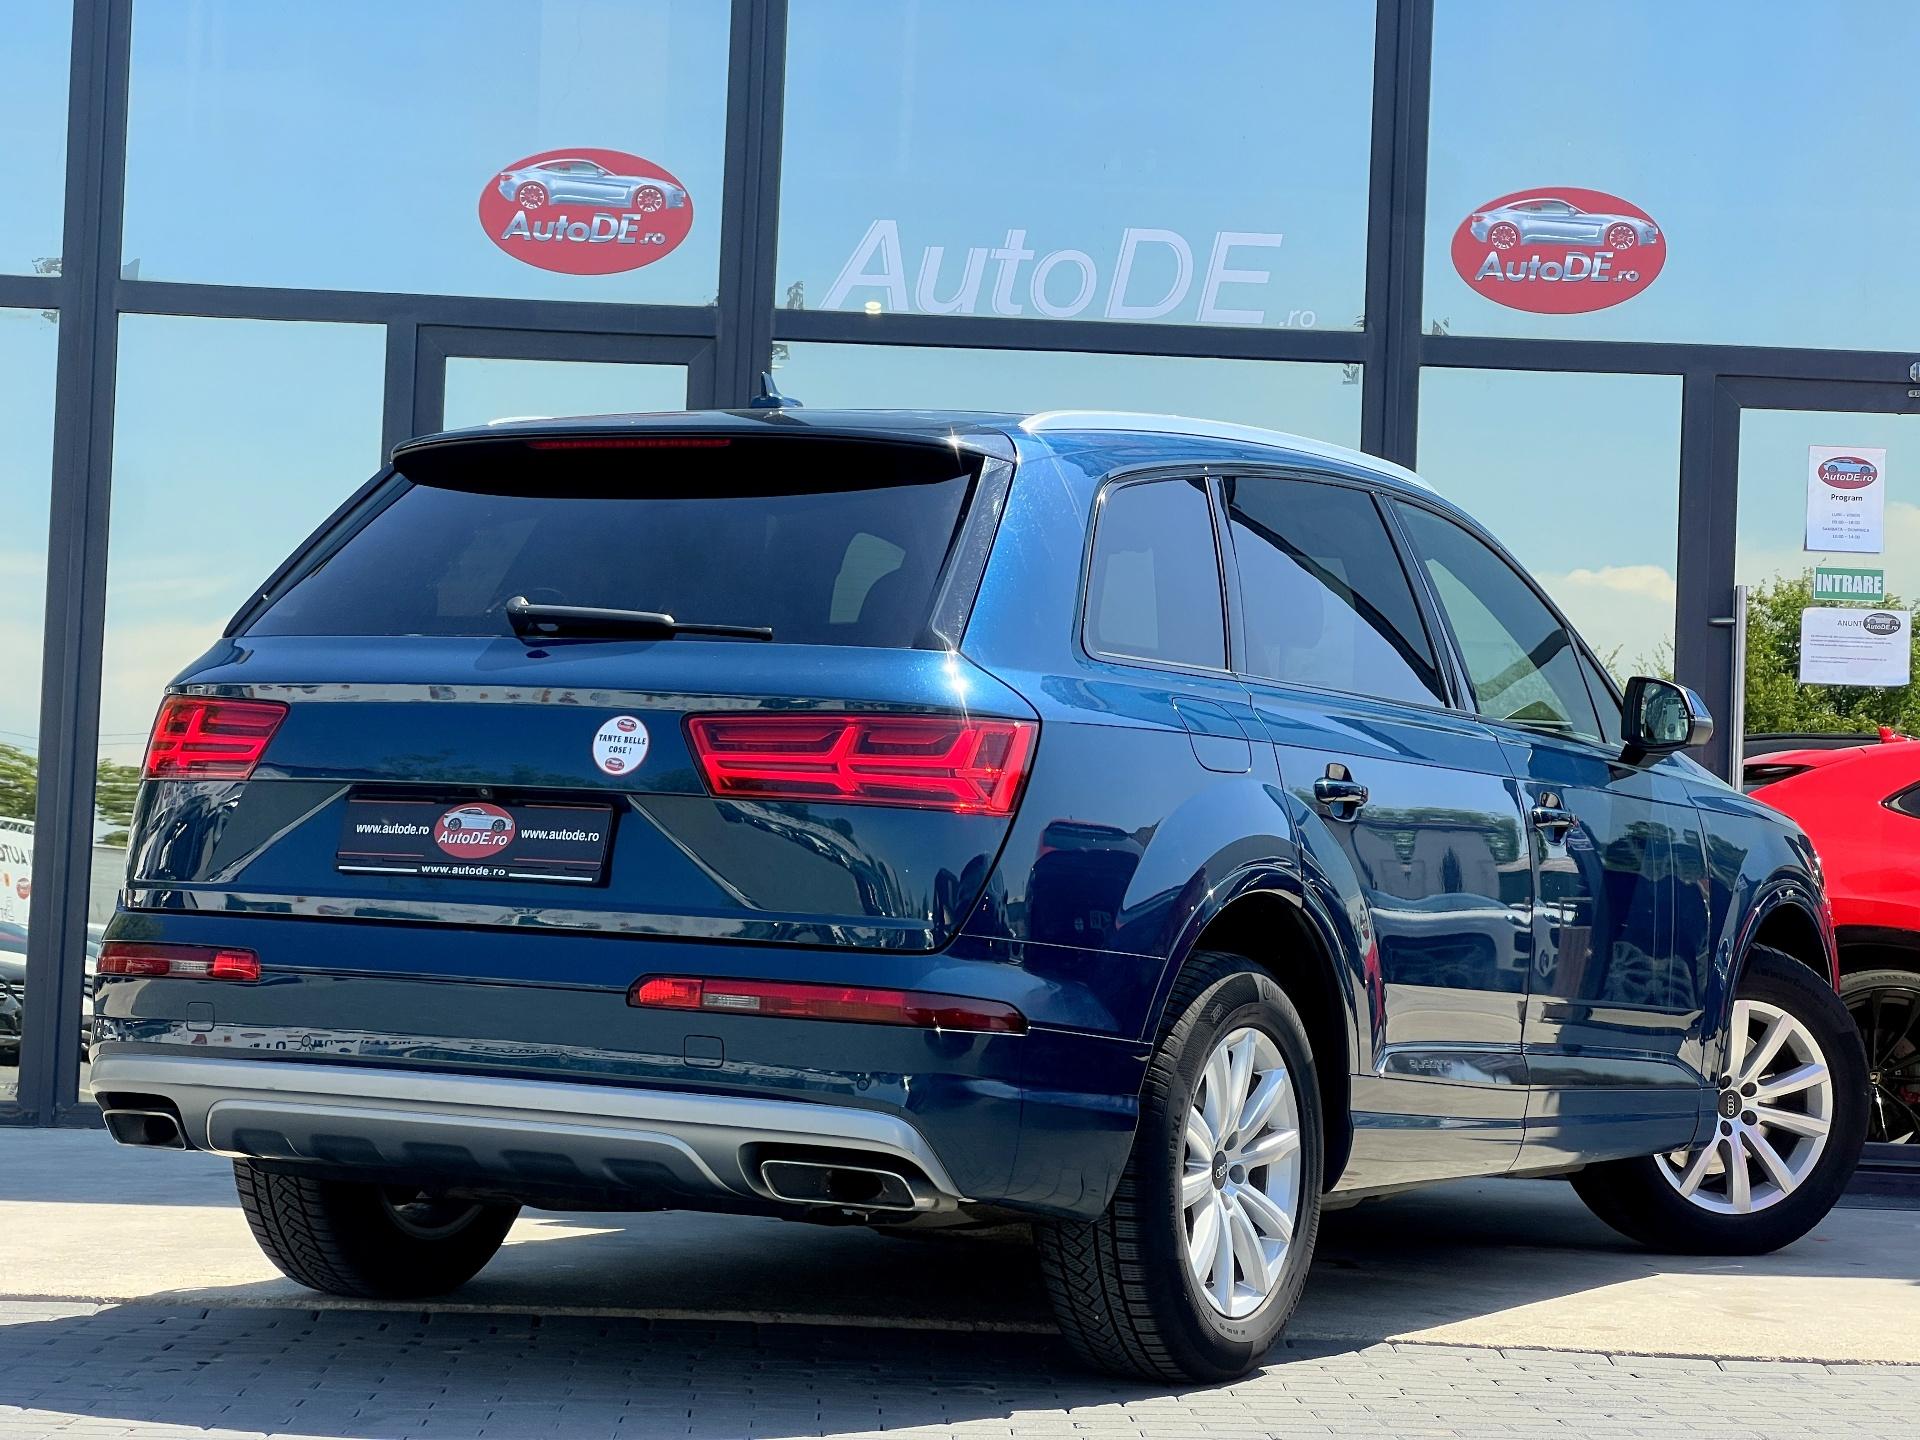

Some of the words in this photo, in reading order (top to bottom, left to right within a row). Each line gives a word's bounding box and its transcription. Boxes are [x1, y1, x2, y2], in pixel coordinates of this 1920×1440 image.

[1822, 472, 1874, 482] AutoDE.ro
[1830, 493, 1863, 503] Program
[1816, 573, 1882, 594] INTRARE
[1837, 619, 1863, 628] ANUNT
[599, 734, 621, 743] TANTE
[624, 736, 647, 745] BELLE
[608, 745, 627, 754] COSE
[356, 822, 430, 836] www.autode.ro
[520, 828, 600, 842] www.autode.ro
[437, 830, 508, 846] AutoDE.ro
[420, 863, 506, 877] www.autode.ro
